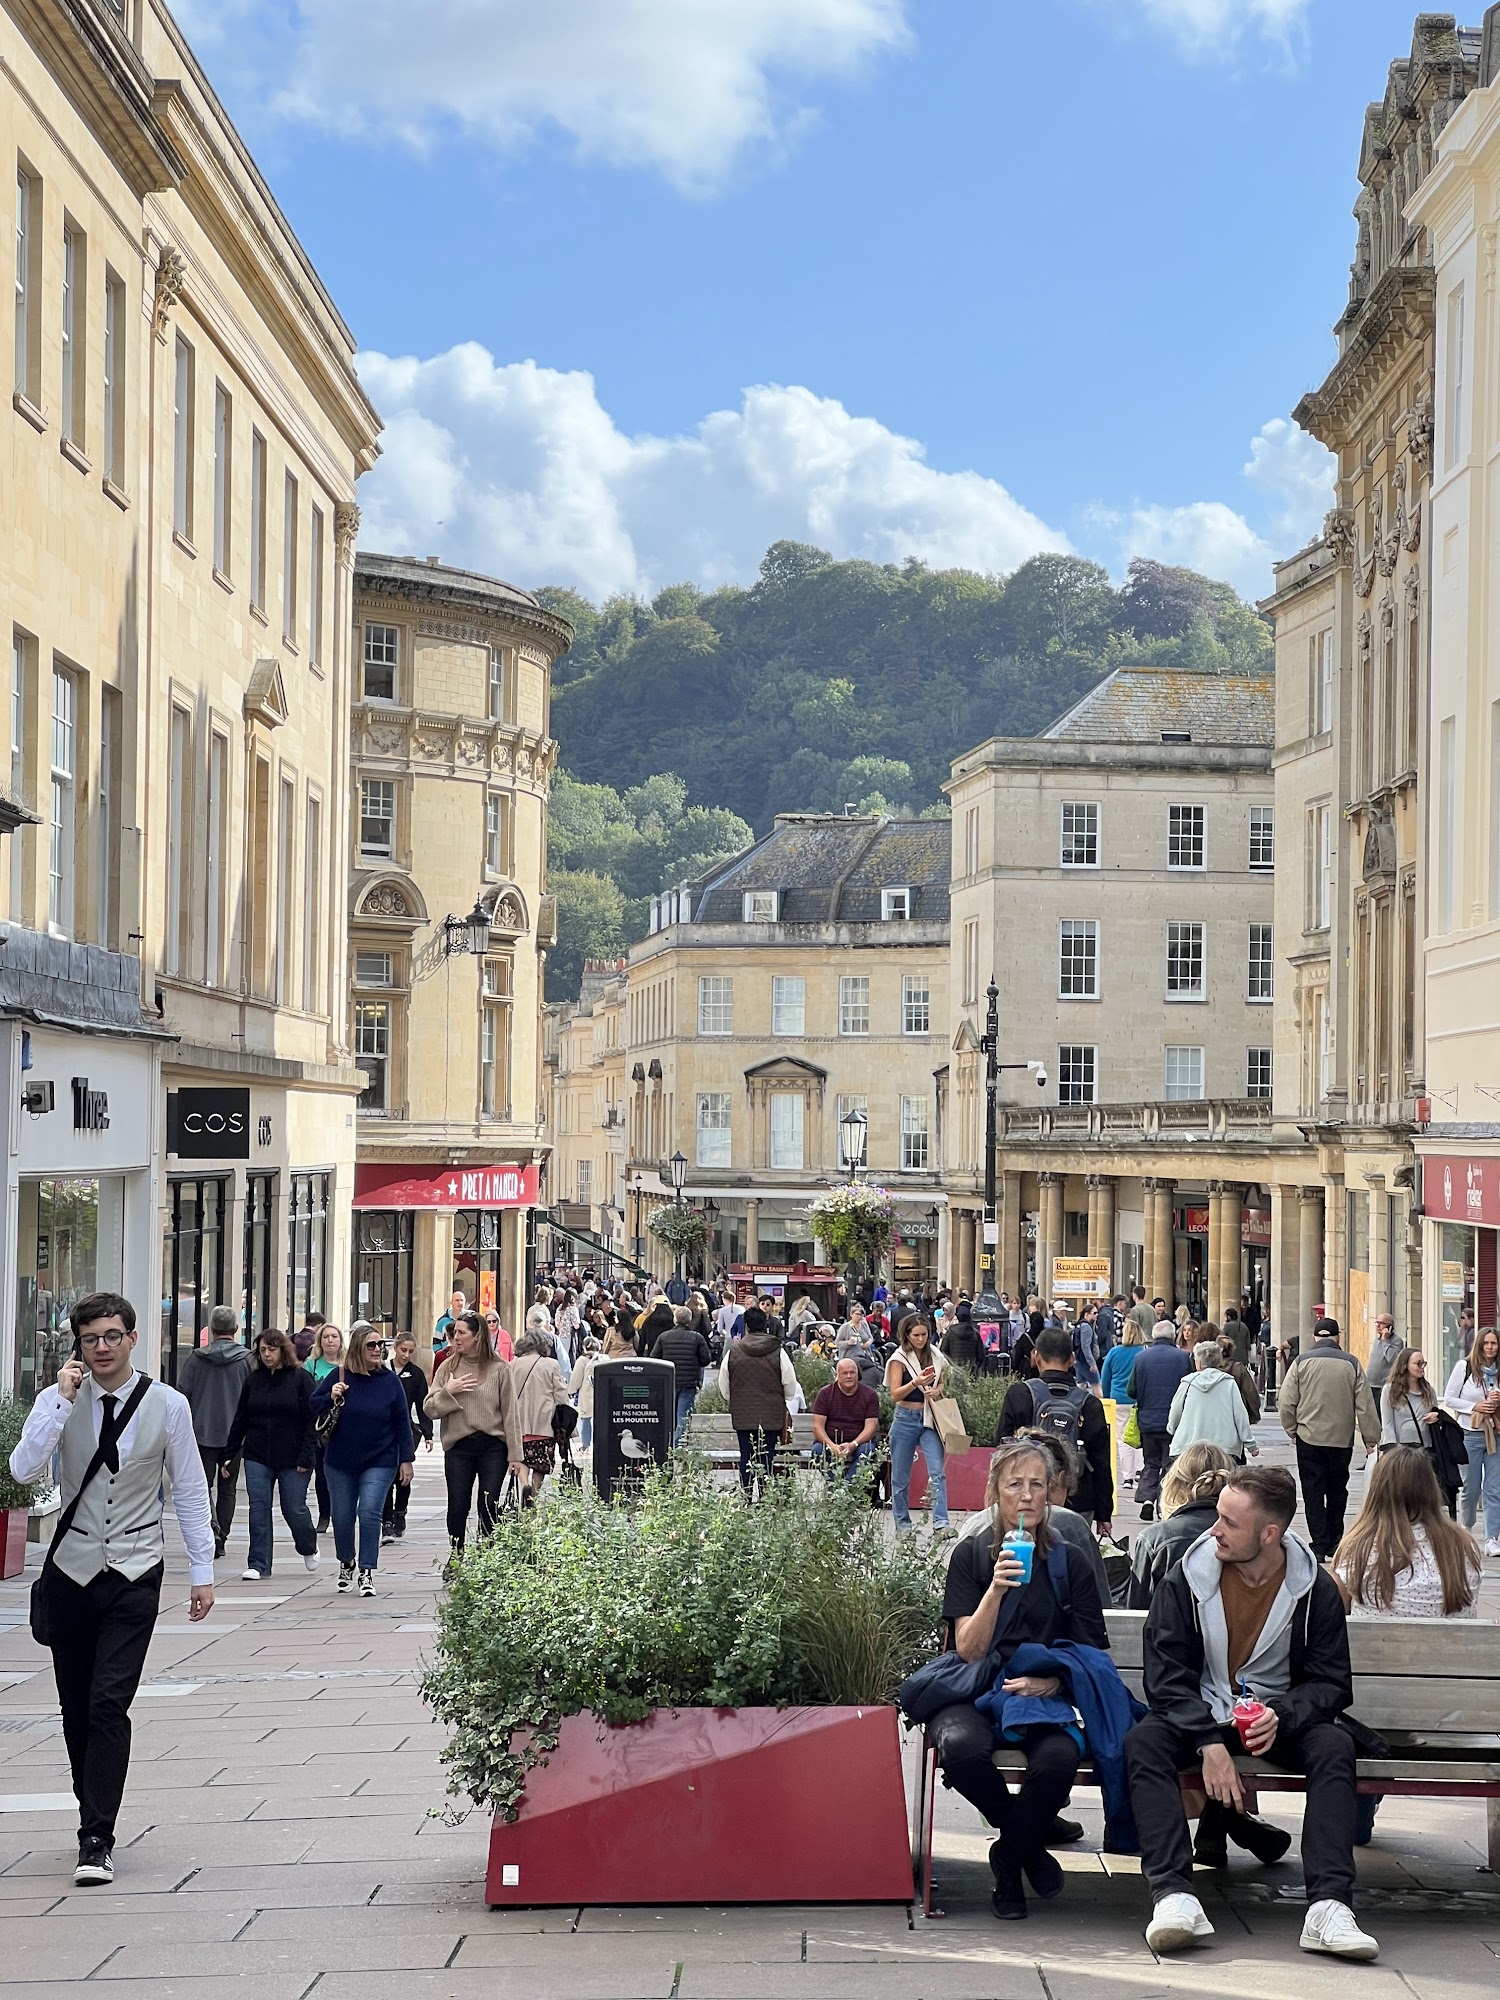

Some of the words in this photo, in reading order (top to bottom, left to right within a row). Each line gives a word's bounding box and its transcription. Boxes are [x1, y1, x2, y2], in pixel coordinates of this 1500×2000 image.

[71, 1077, 110, 1129] Three
[184, 1113, 243, 1133] COS
[259, 1116, 271, 1145] COS
[462, 1173, 484, 1201] PRET
[485, 1173, 490, 1200] A
[493, 1172, 518, 1200] MANGER
[904, 1224, 935, 1235] ecco
[1188, 1224, 1209, 1232] LEON
[1056, 1263, 1081, 1271] Repair
[1083, 1263, 1108, 1271] Centre
